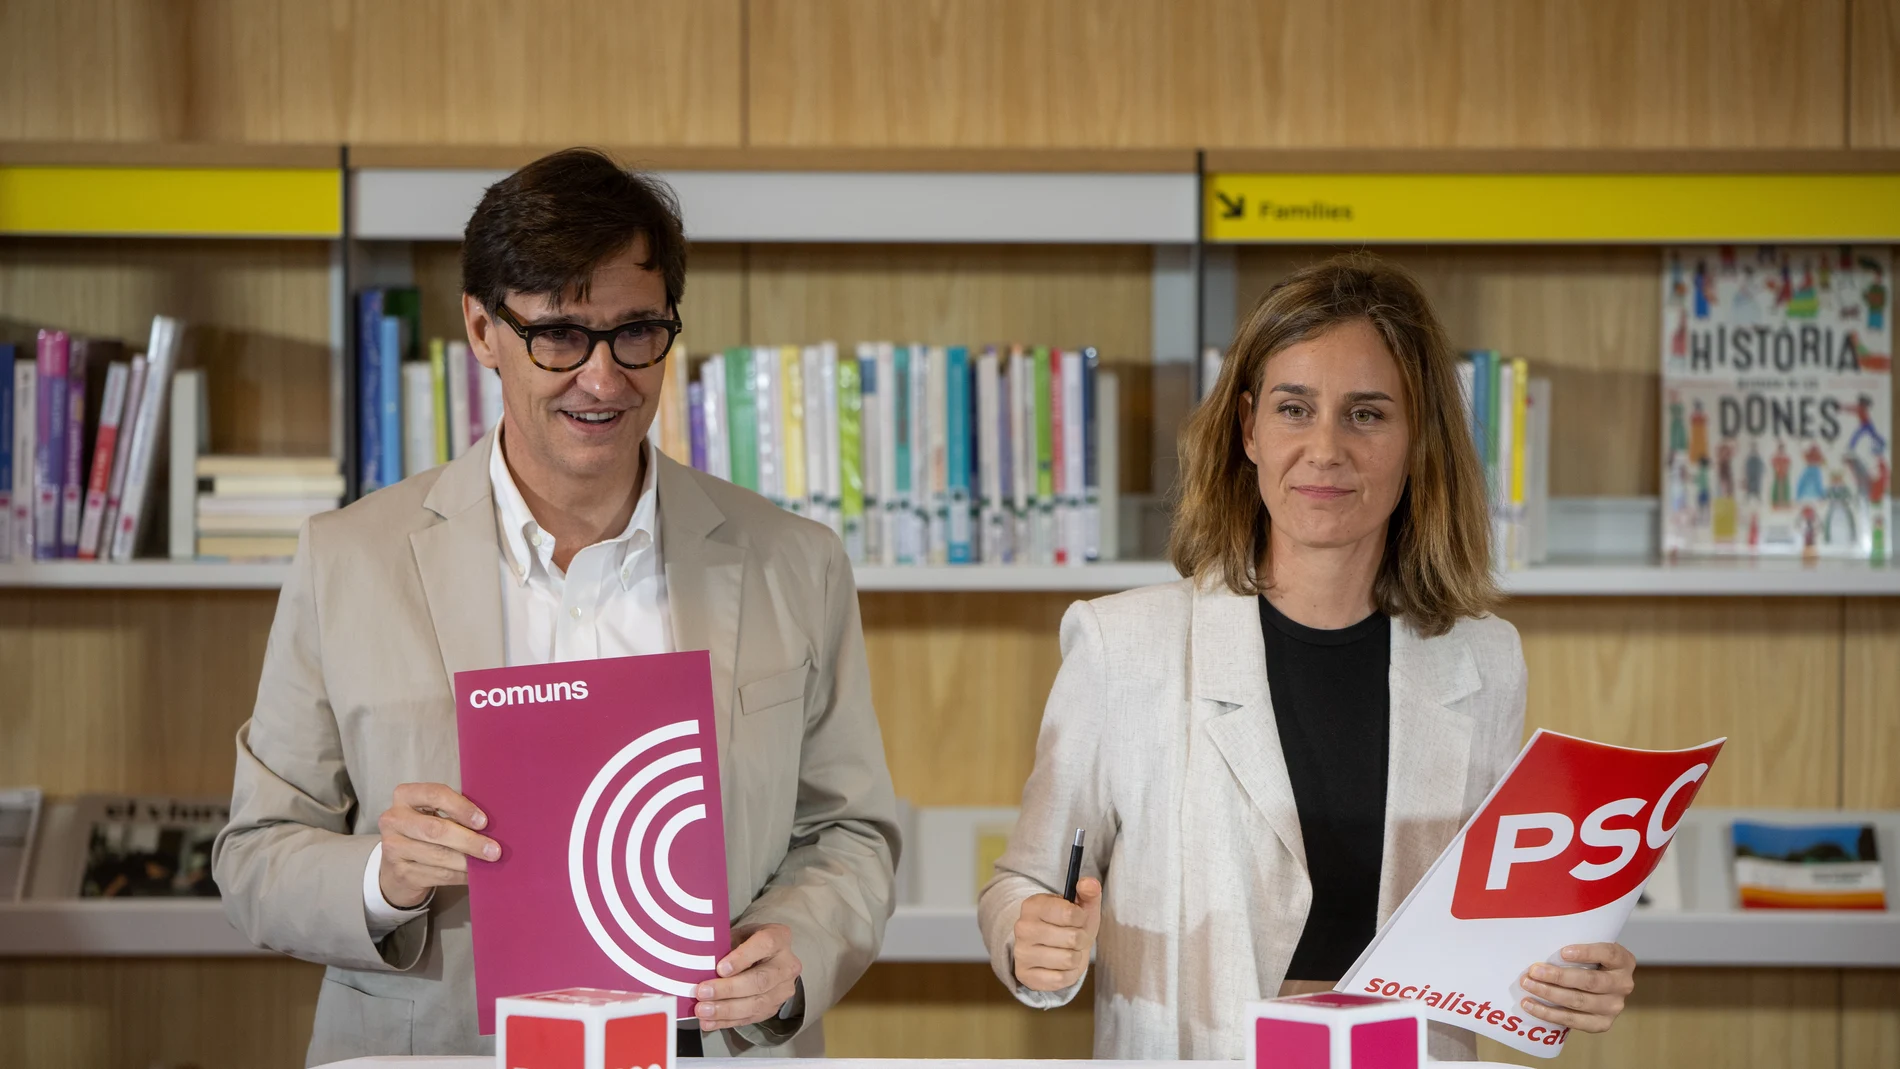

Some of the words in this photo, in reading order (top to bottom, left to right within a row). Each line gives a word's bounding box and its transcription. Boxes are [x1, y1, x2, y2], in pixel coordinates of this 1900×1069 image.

[1259, 201, 1353, 222] Families
[1719, 393, 1841, 442] DONES
[469, 680, 589, 709] comuns
[1485, 762, 1709, 891] PSC
[1364, 976, 1570, 1046] socialistes.cat
